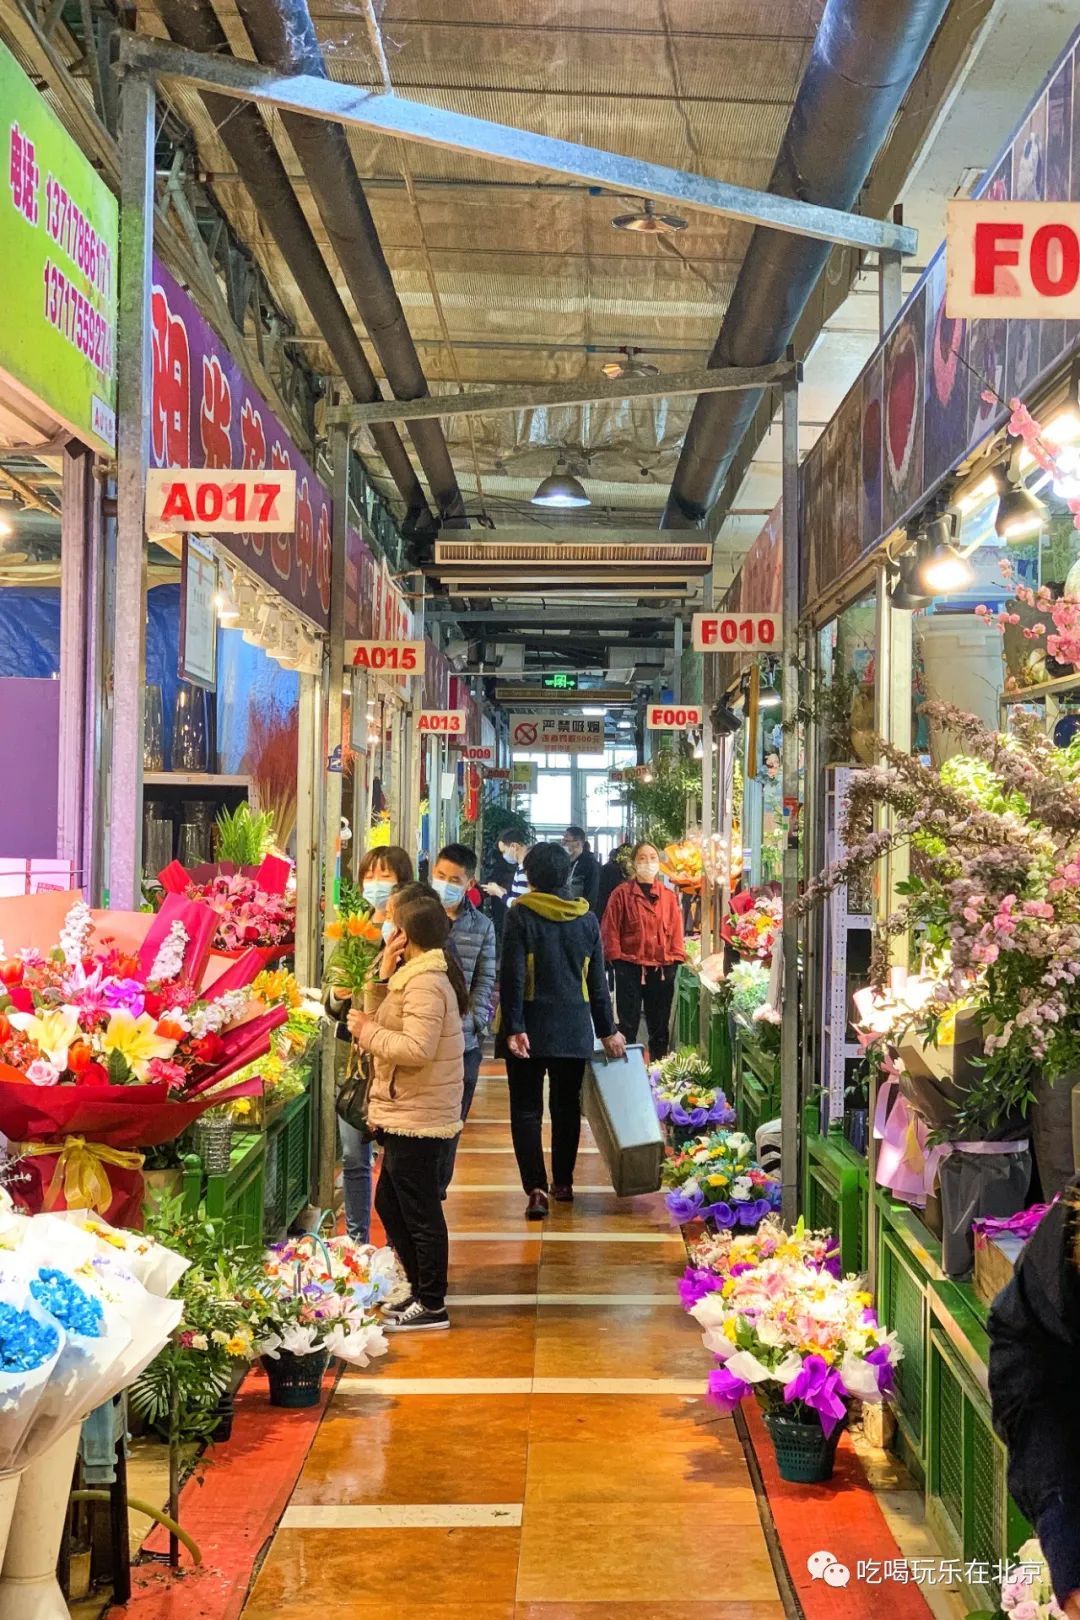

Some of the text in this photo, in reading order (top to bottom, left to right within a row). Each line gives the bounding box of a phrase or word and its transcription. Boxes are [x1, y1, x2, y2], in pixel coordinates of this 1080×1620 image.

[160, 481, 281, 523] A017
[701, 618, 775, 645] F010
[352, 646, 417, 670] A015
[418, 714, 460, 731] A013
[542, 719, 600, 733] 严禁吸烟
[652, 708, 698, 726] F009
